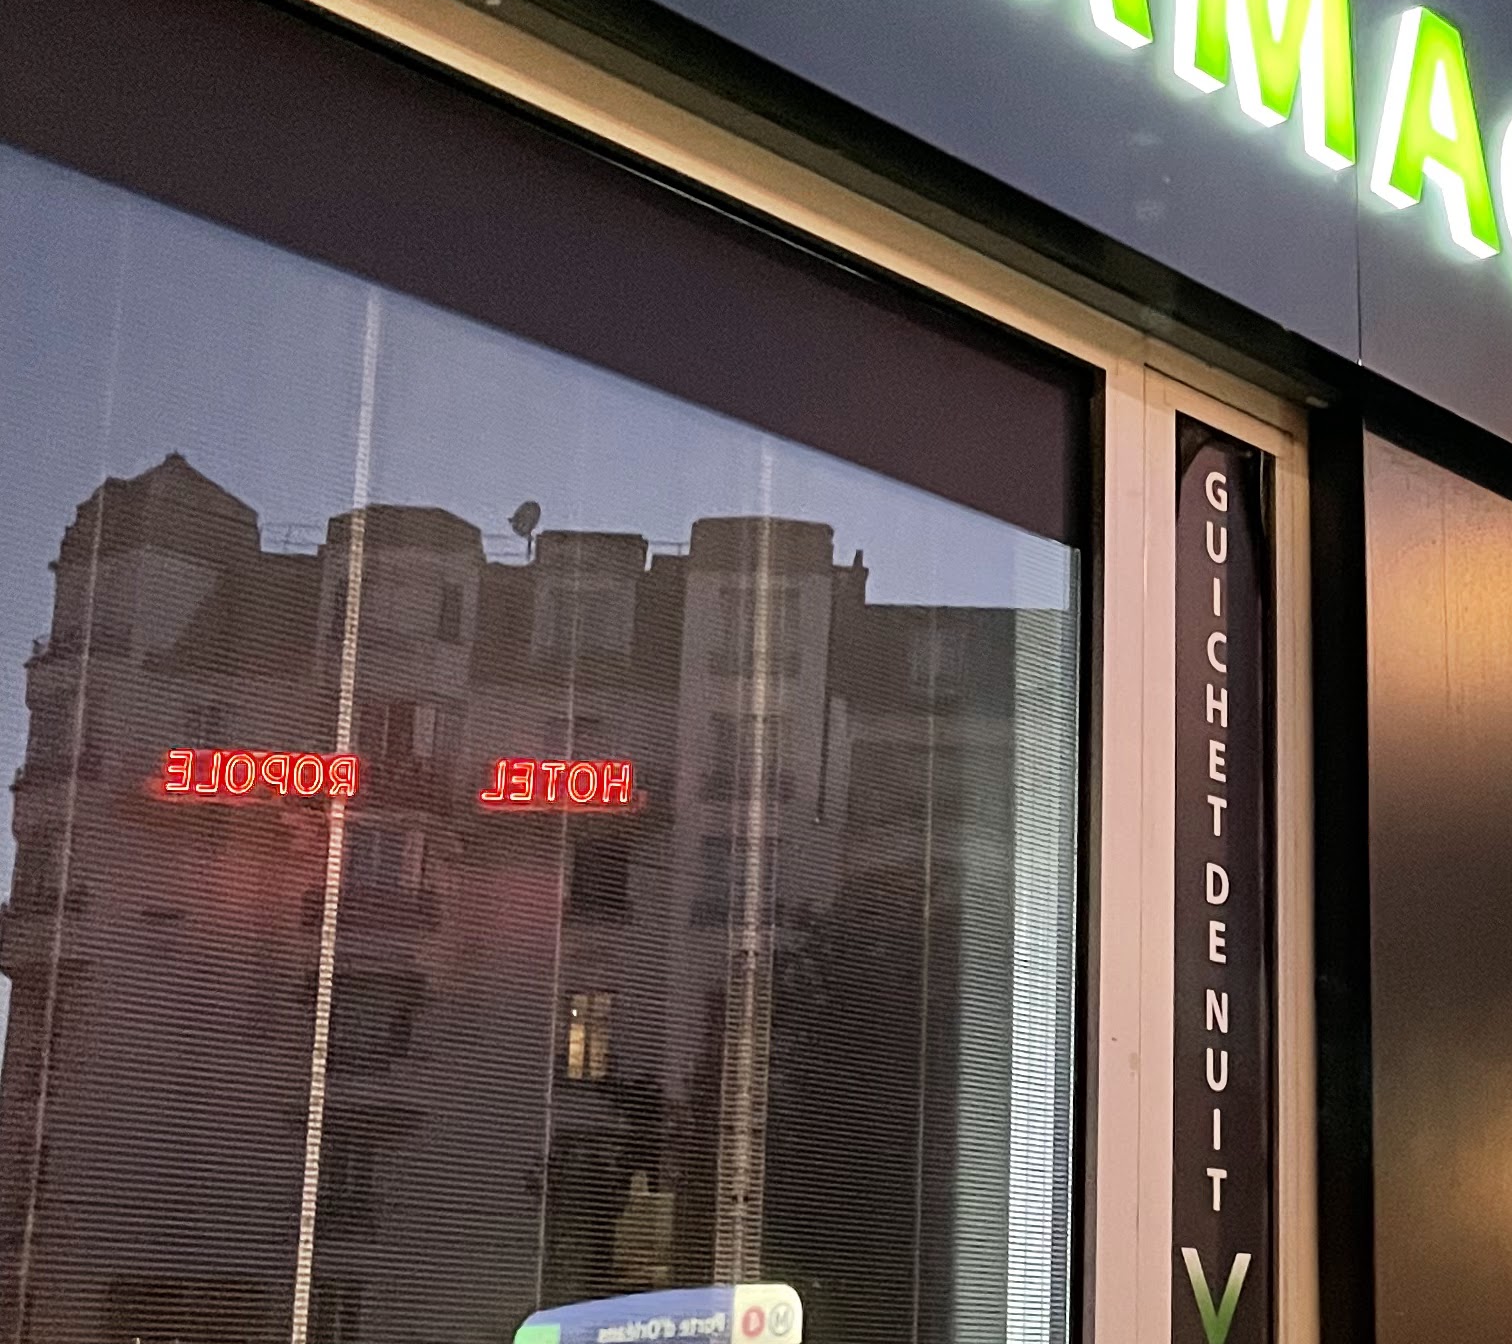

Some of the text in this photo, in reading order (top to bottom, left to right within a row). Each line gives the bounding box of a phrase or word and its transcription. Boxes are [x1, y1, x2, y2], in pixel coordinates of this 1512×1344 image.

[1203, 470, 1230, 1213] GUICHET DE NUIT
